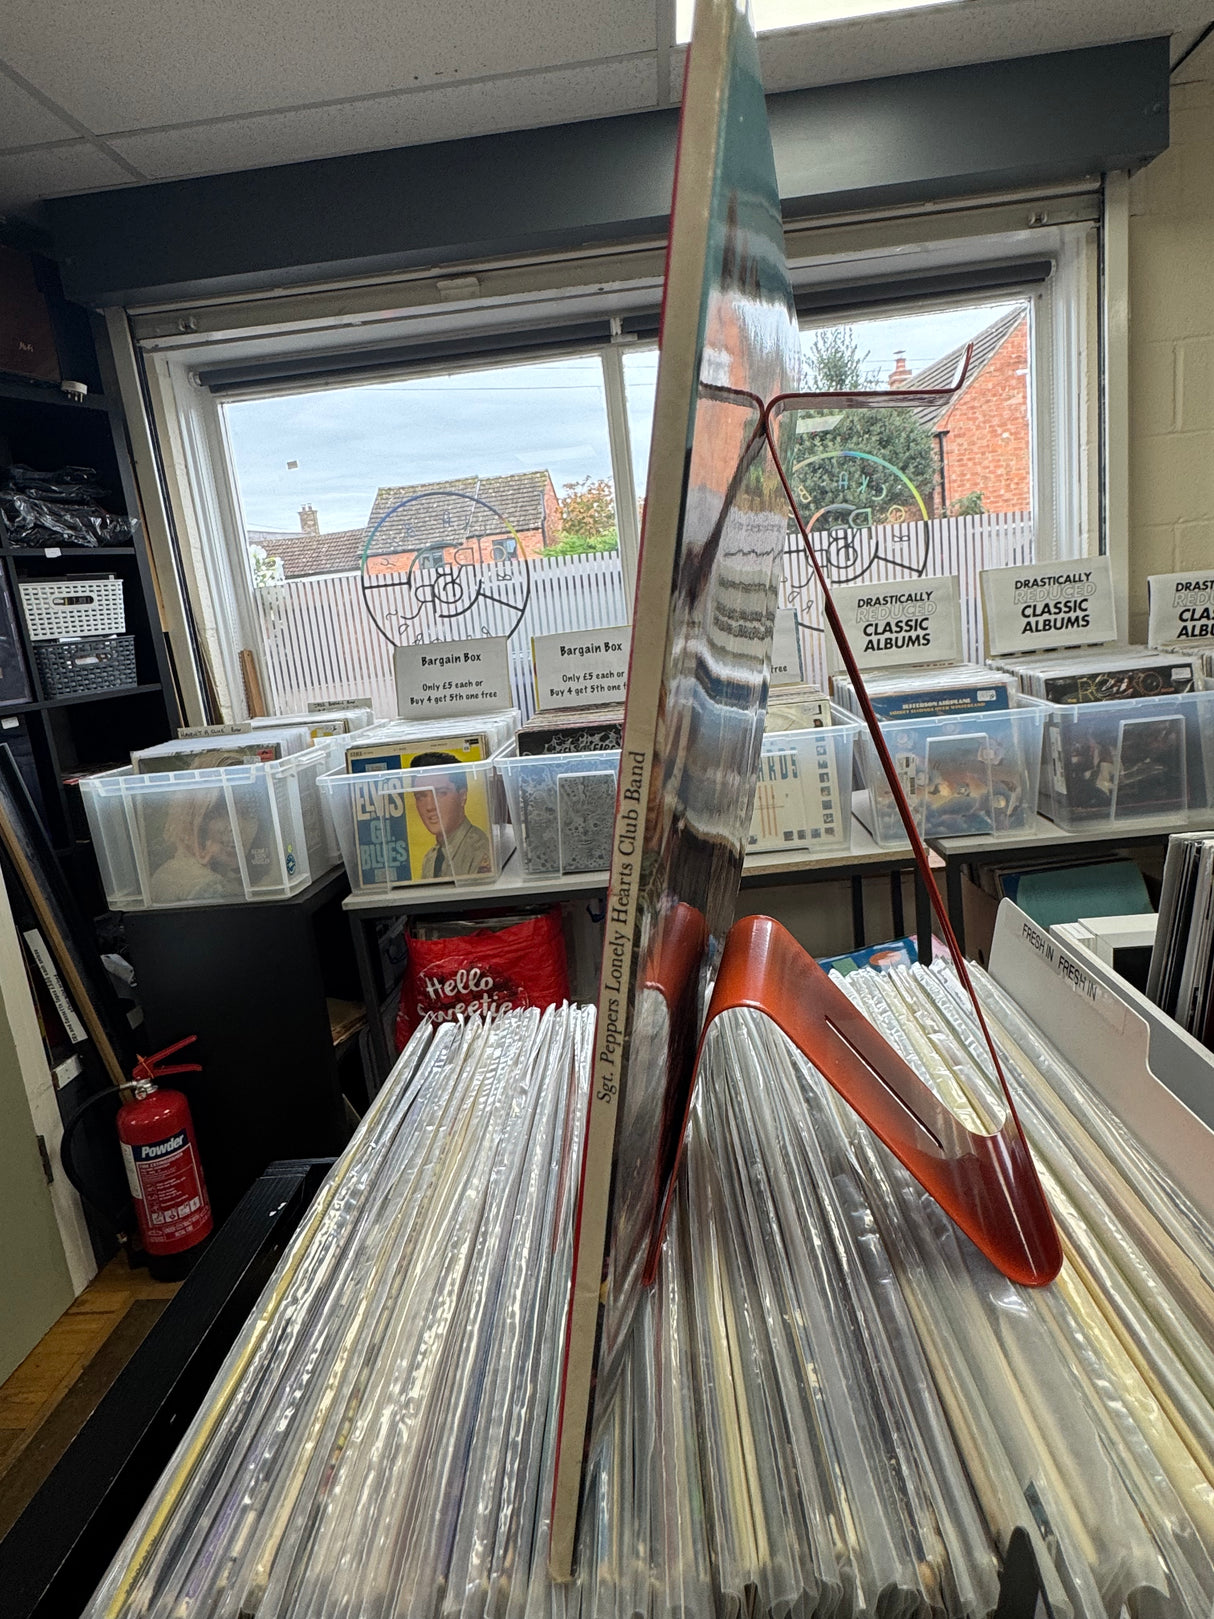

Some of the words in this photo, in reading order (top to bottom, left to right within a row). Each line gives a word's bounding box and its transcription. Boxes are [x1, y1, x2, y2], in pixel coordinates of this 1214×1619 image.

[1015, 572, 1092, 590] DRASTICALLY
[857, 591, 934, 608] DRASTICALLY
[1013, 581, 1097, 605] REDUCED
[856, 601, 937, 624] REDUCED
[1021, 598, 1089, 619] CLASSIC
[1178, 607, 1214, 622] CLA
[863, 617, 929, 637] CLASSIC
[1021, 614, 1090, 634] ALBUMS
[560, 643, 601, 657] Bargain
[604, 641, 622, 652] Box
[864, 633, 931, 652] ALBUMS
[421, 654, 461, 667] Bargain
[463, 653, 481, 662] Box
[422, 683, 440, 692] Only
[443, 681, 452, 690] £5
[455, 680, 473, 688] each
[562, 674, 580, 683] Only
[583, 672, 593, 681] £5
[595, 670, 614, 679] each
[410, 697, 424, 705] Buy
[426, 696, 432, 704] 4
[434, 695, 447, 704] get
[449, 693, 464, 702] 5th
[481, 691, 497, 699] free
[550, 688, 565, 697] Buy
[567, 687, 573, 695] 4
[574, 685, 588, 696] get
[590, 684, 605, 693] 5th
[607, 684, 621, 692] one
[624, 751, 646, 802] Band
[618, 809, 639, 856] Club
[360, 840, 407, 869] BLUES
[611, 862, 633, 925] Hearts
[605, 931, 631, 994] Lonely
[1022, 923, 1046, 954] FRESH
[1046, 944, 1054, 962] IN
[1058, 955, 1086, 991] FRESH
[1087, 981, 1097, 1001] IN
[425, 968, 494, 1000] Hello
[600, 999, 624, 1066] Peppers
[597, 1072, 617, 1104] Sgt.
[141, 1135, 184, 1158] Powder
